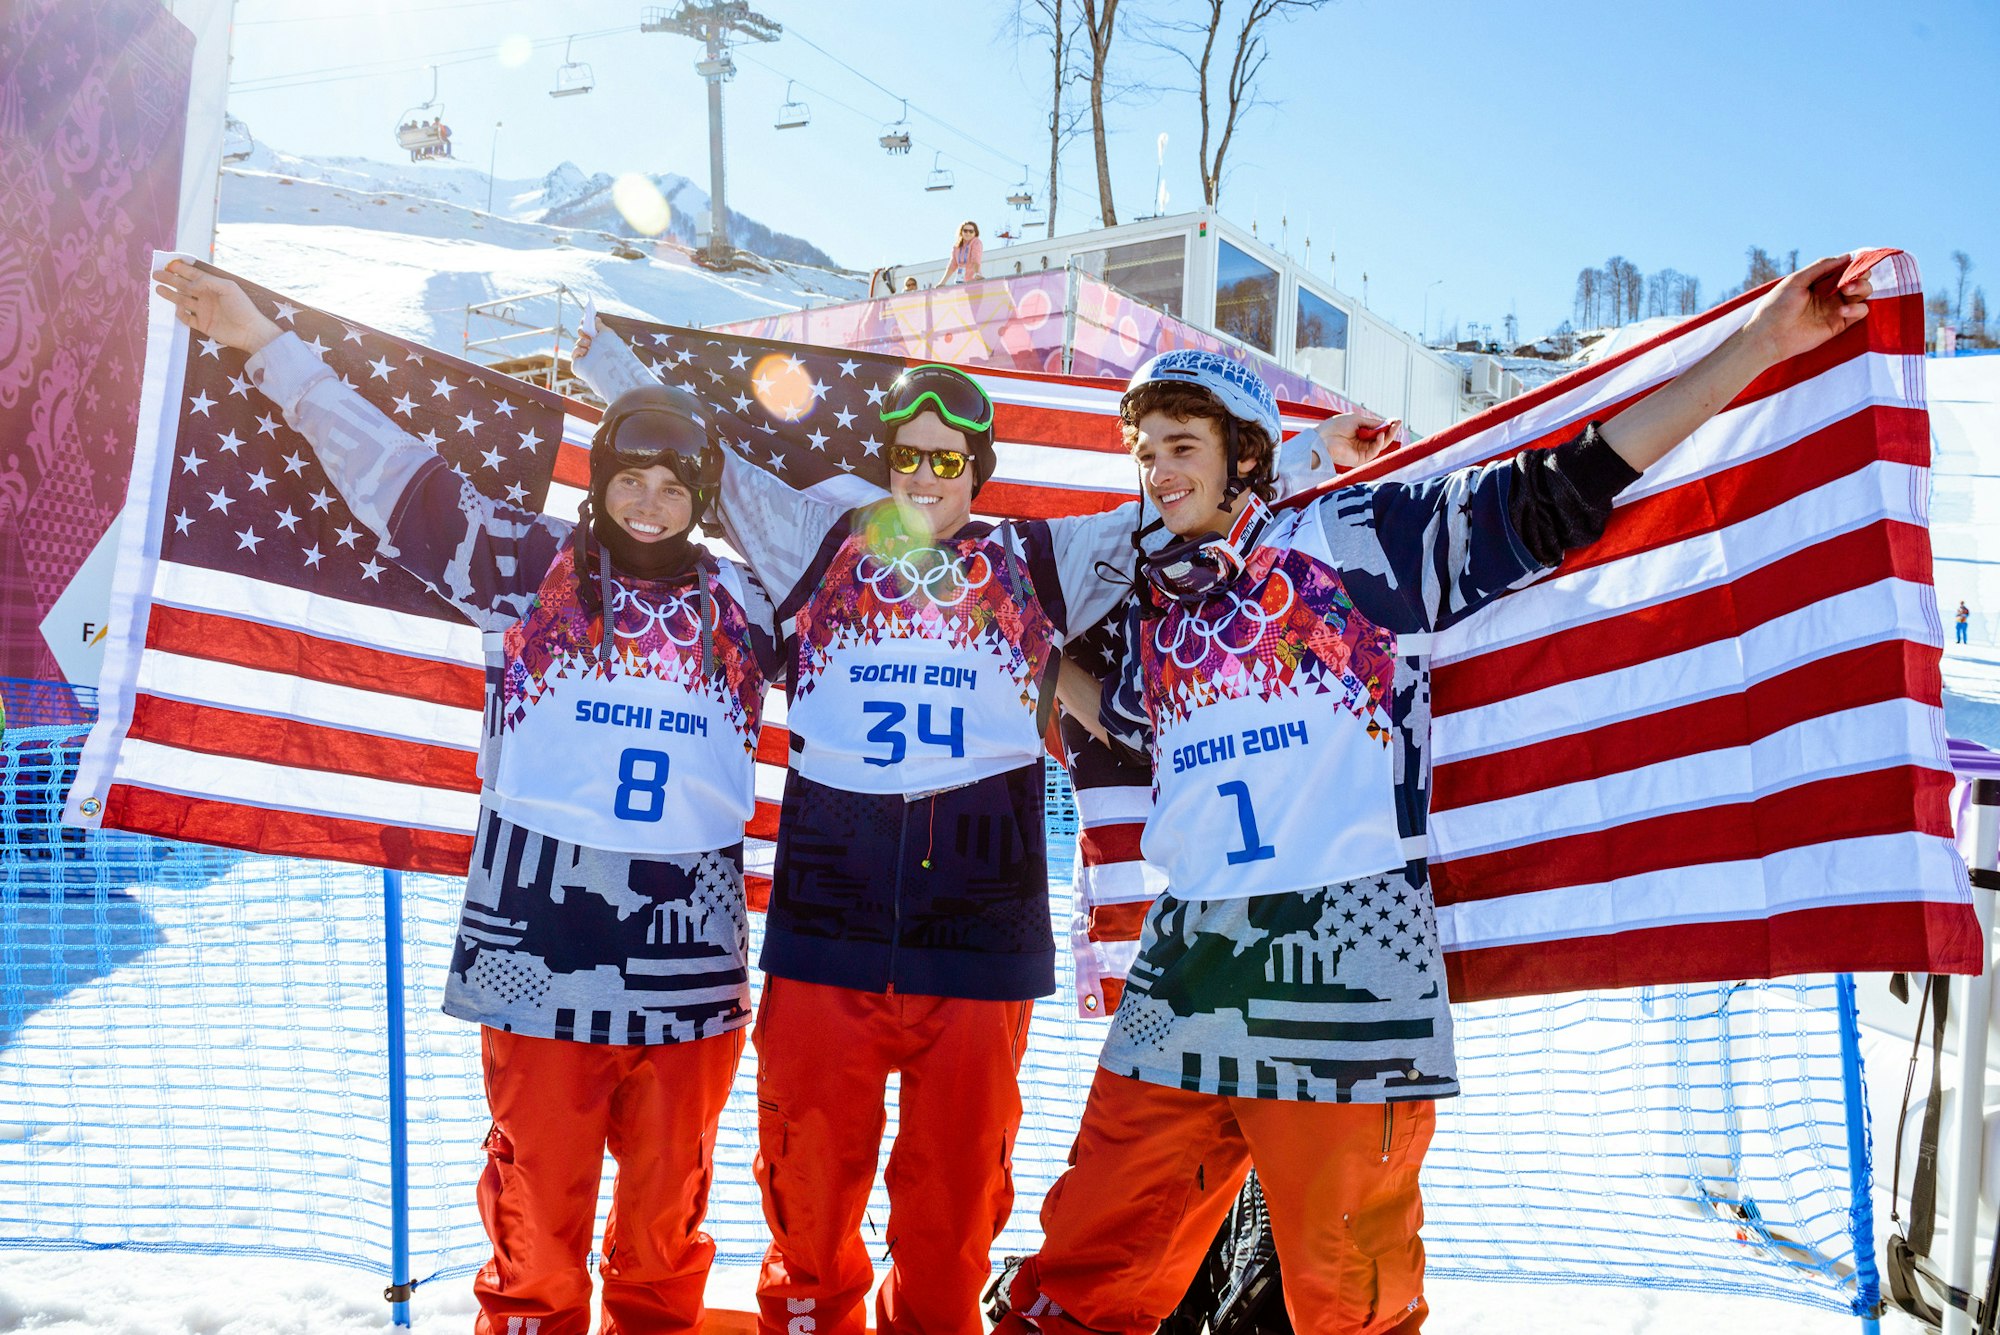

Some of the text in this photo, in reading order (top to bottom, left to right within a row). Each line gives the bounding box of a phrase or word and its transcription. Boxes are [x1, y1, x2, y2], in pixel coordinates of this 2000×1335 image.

[1240, 519, 1256, 543] SMITH
[849, 663, 977, 690] SOCHI 2014
[575, 699, 708, 738] SOCHI 2014
[862, 700, 965, 768] 34
[1173, 720, 1309, 774] SOCHI 2014
[613, 747, 670, 823] 8
[1216, 779, 1276, 866] 1
